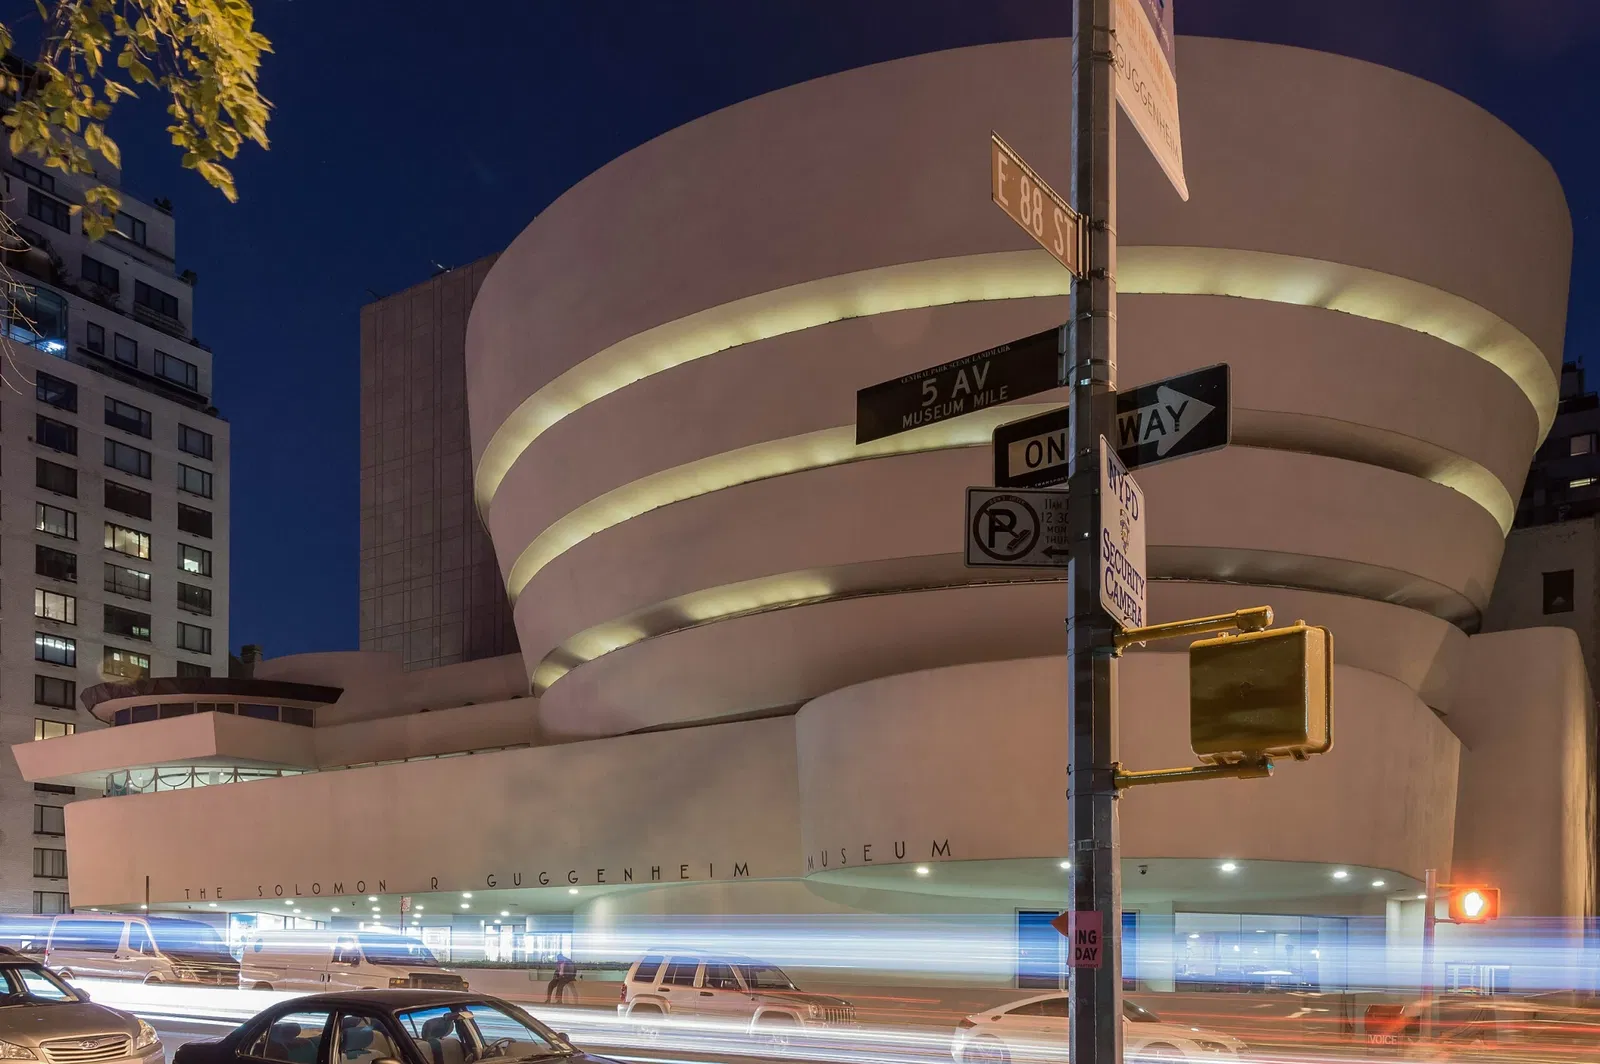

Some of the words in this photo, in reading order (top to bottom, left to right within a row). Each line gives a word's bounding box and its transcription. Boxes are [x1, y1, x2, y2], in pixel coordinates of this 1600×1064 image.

[1115, 43, 1180, 163] GUGGENHEIM
[997, 150, 1009, 207] E
[1020, 175, 1043, 237] 88
[1053, 207, 1073, 264] ST
[921, 377, 938, 407] 5
[951, 360, 990, 398] AV
[930, 365, 948, 376] PARK
[902, 399, 964, 429] MUSEUM
[973, 385, 1009, 408] MILE
[1025, 432, 1065, 468] ON
[1118, 400, 1189, 446] WAY
[1108, 457, 1139, 521] NYPD
[1046, 536, 1070, 544] THUR
[1103, 527, 1145, 600] SECURITY
[1104, 567, 1143, 628] CAMERA
[185, 887, 223, 900] THE
[258, 880, 386, 897] SOLOMON
[431, 877, 438, 889] R
[486, 862, 750, 888] GUGGENHEIM
[807, 839, 952, 871] MUSEUM
[1075, 929, 1097, 945] ING
[1075, 947, 1098, 961] DAY
[1369, 1034, 1398, 1045] VOICE
